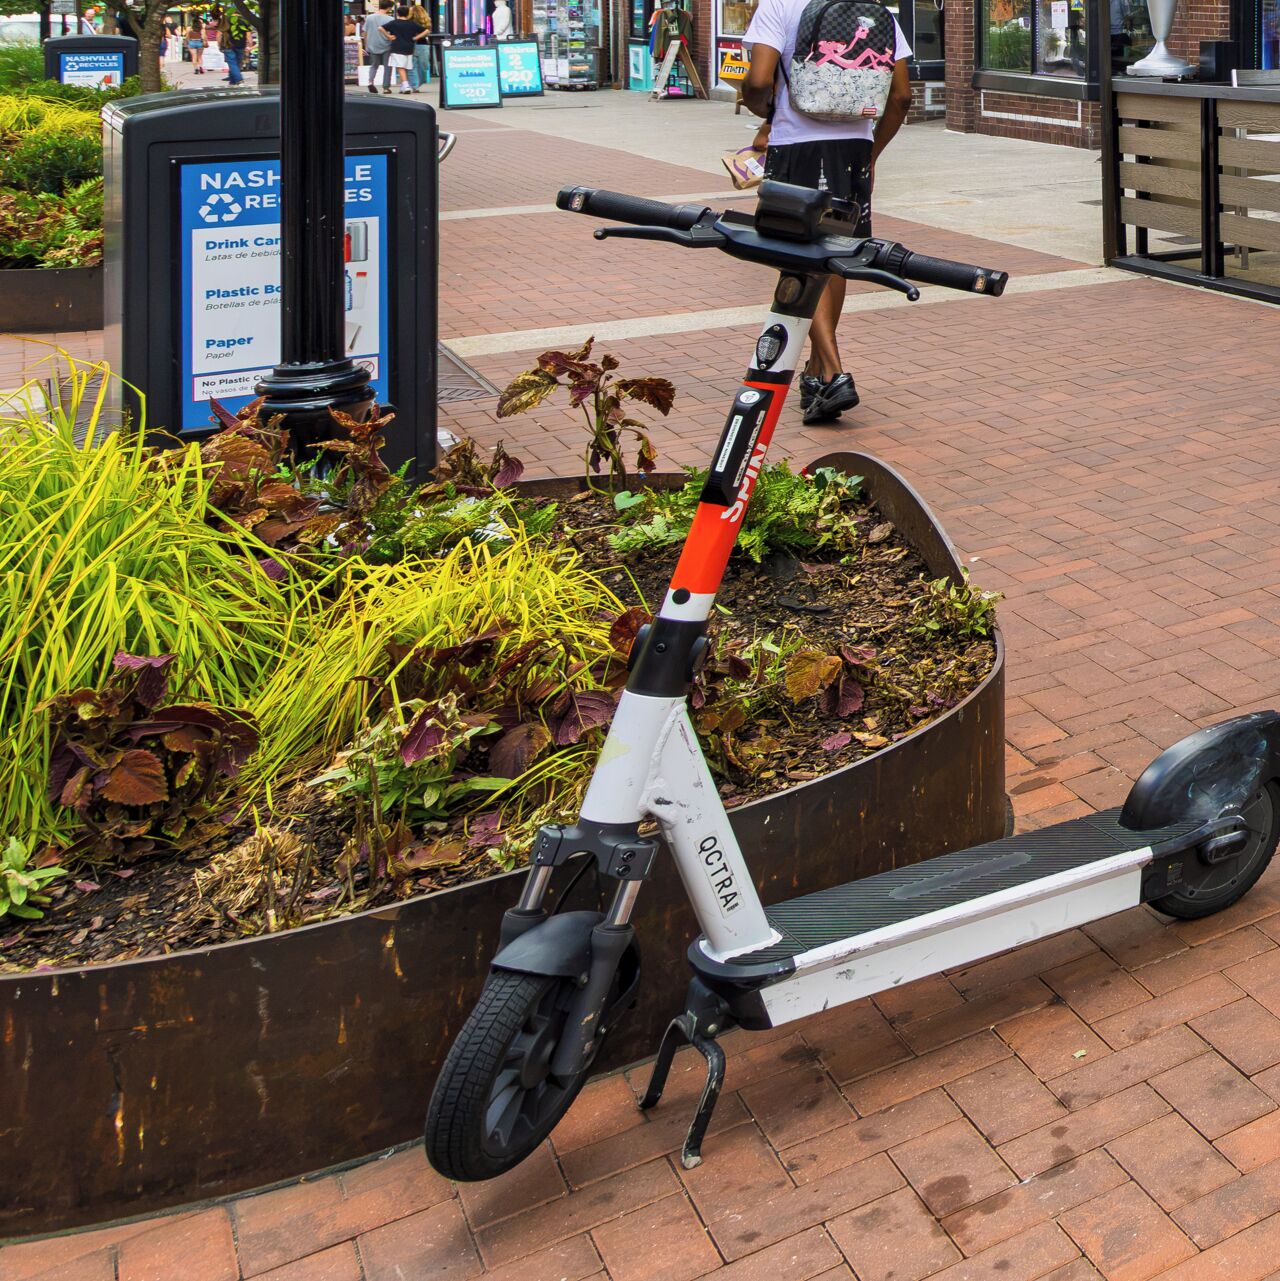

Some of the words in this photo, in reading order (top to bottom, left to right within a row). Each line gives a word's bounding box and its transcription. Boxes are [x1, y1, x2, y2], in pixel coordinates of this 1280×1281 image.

[201, 164, 372, 190] NASHE
[245, 188, 373, 209] REES
[205, 236, 249, 250] Drink
[253, 235, 281, 247] Can
[205, 252, 232, 262] Latas
[235, 251, 247, 259] de
[205, 286, 260, 299] Plastic
[205, 300, 245, 311] Botellas
[248, 298, 261, 307] de
[205, 336, 254, 349] Paper
[205, 350, 234, 360] Papel
[219, 376, 250, 385] Plastic
[215, 386, 237, 395] vasos
[239, 385, 249, 393] de
[720, 442, 768, 522] SPIN
[698, 835, 739, 909] QCTRA
